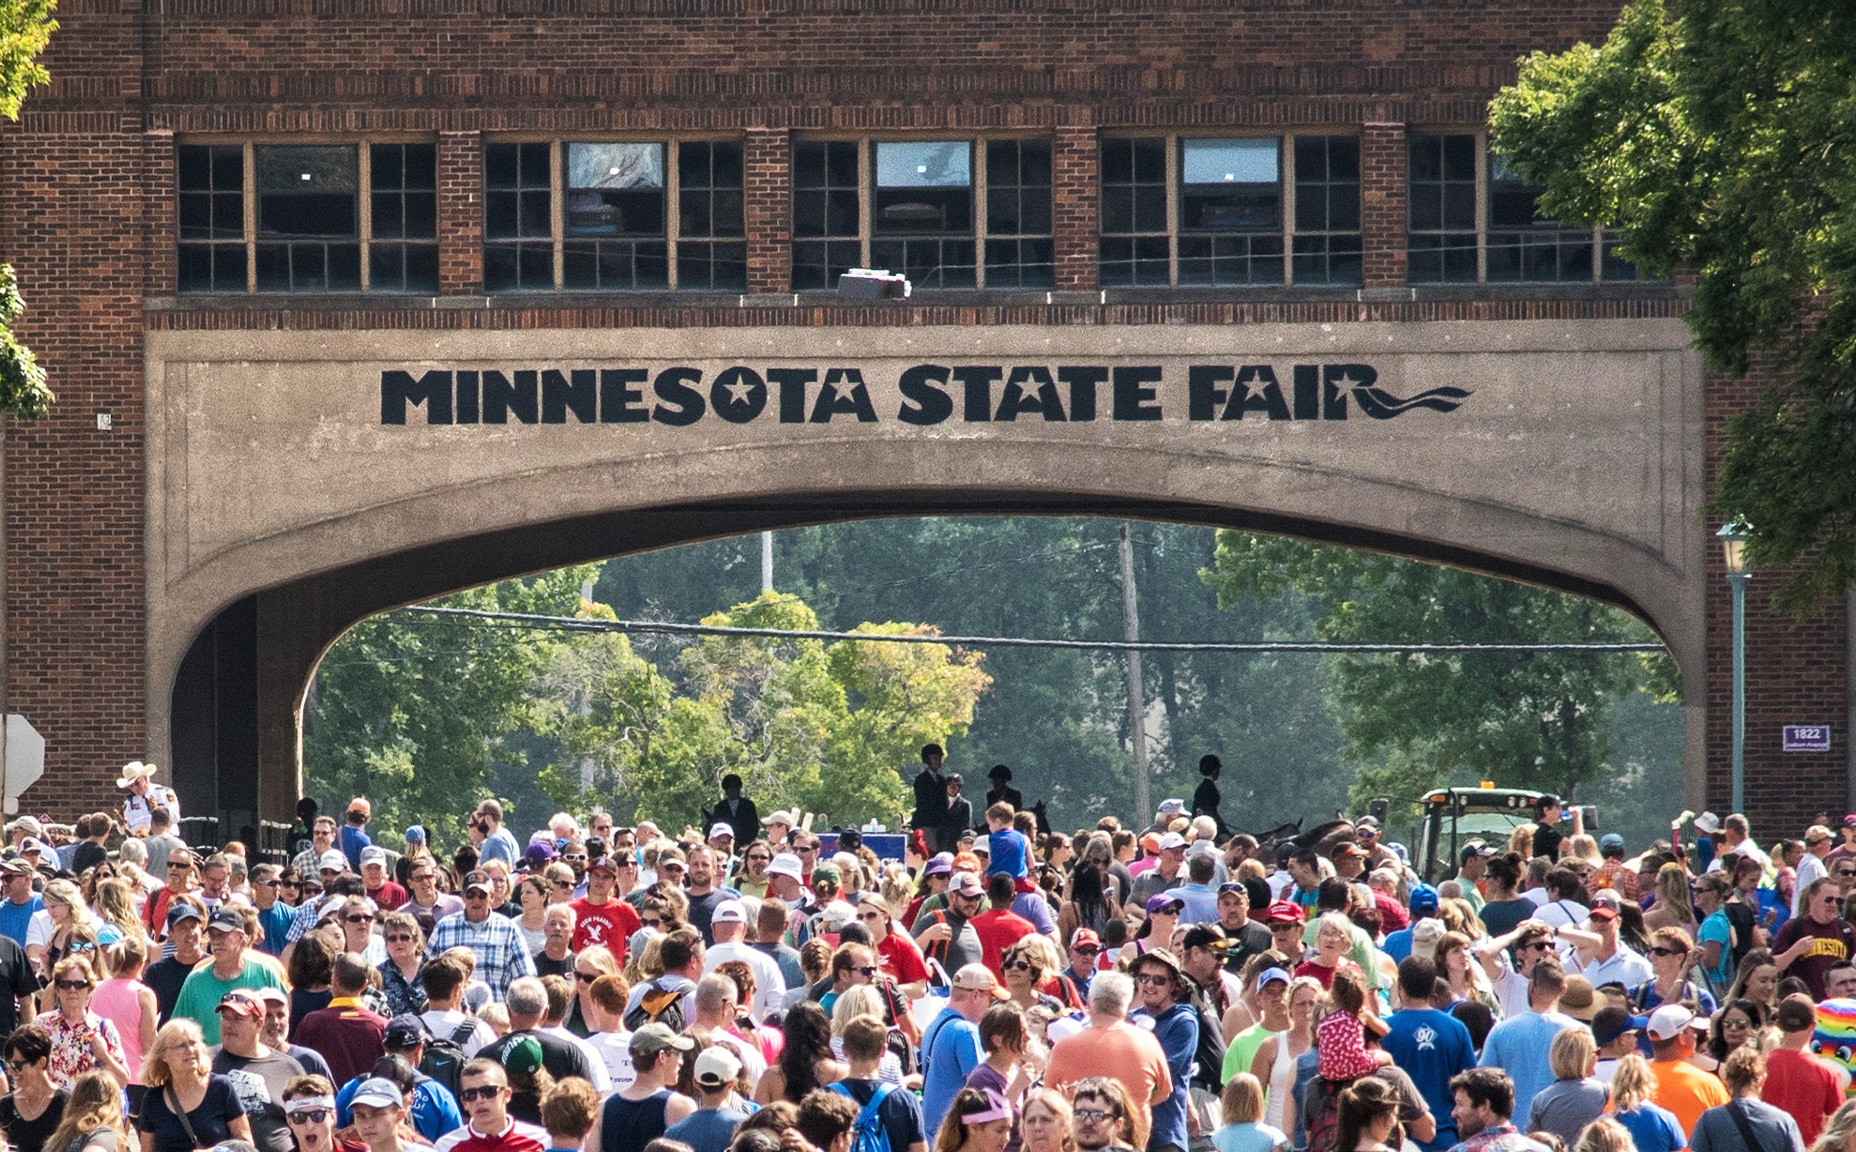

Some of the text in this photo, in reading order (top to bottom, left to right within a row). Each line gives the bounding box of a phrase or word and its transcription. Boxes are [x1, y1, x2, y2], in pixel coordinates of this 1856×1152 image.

[380, 363, 1475, 427] MINNESOTA STATE FAIR
[1793, 728, 1821, 739] 1822
